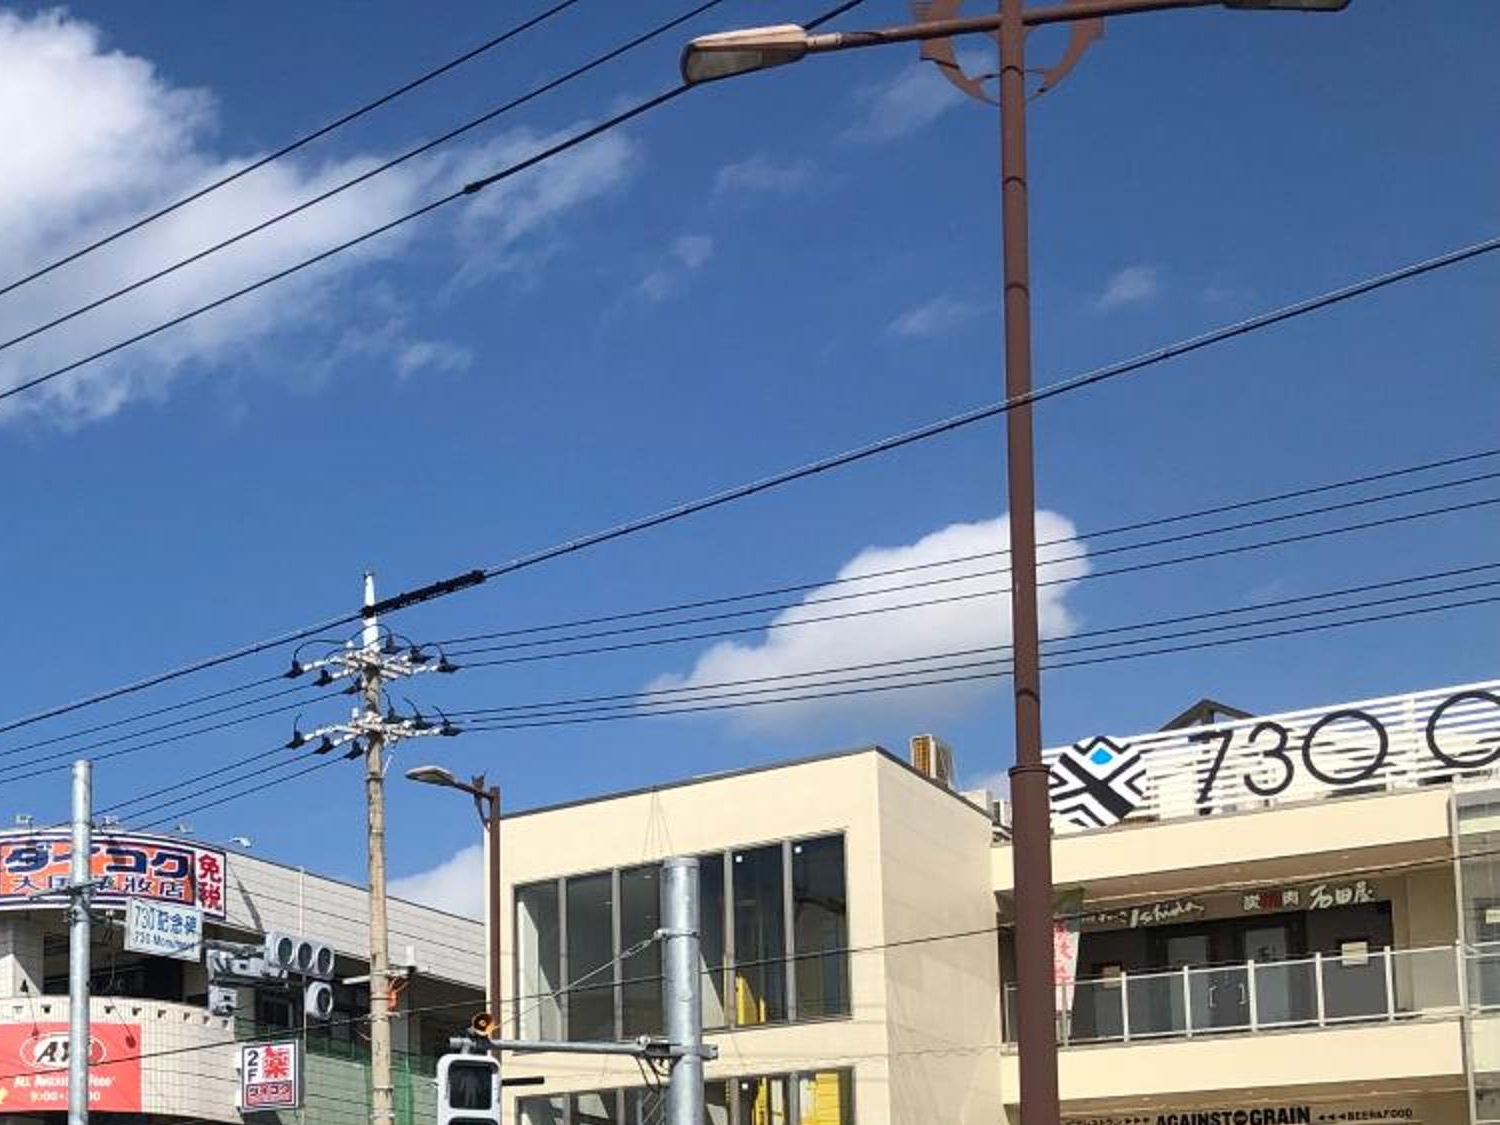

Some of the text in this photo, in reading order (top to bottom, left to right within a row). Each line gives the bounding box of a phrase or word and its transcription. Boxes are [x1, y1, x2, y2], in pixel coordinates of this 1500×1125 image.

[1188, 709, 1388, 814] 730
[198, 853, 222, 912] 免税
[247, 1049, 259, 1082] 2F
